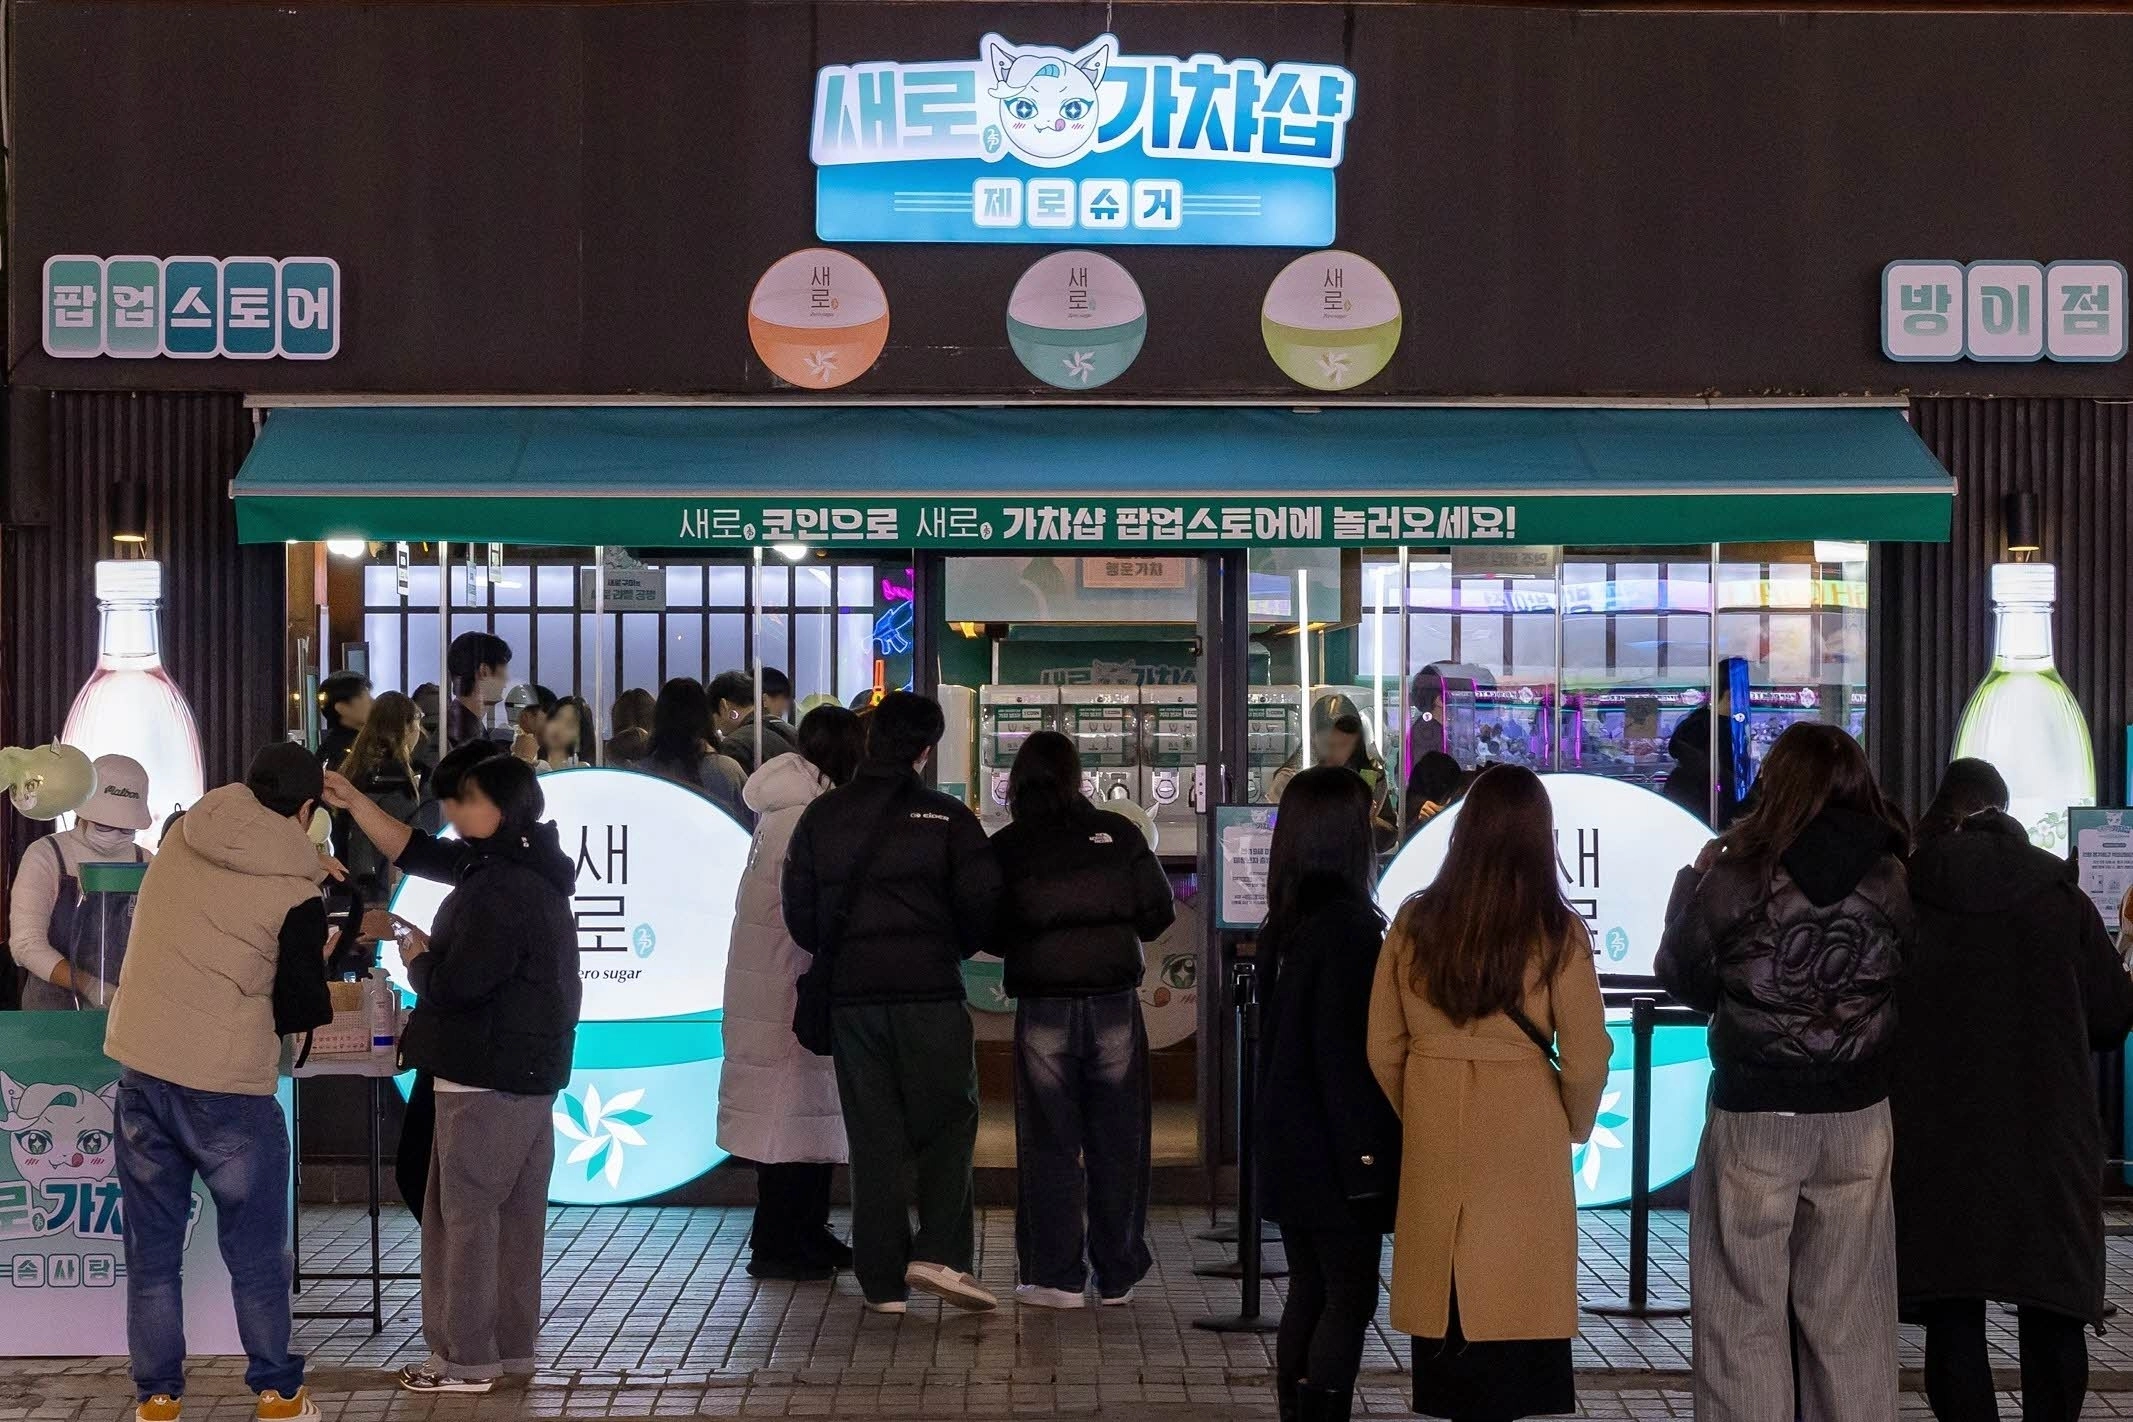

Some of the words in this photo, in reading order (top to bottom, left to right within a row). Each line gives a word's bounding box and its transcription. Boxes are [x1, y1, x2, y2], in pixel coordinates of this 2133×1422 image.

[822, 70, 979, 150] 새로
[1098, 64, 1344, 158] 가챠샵
[54, 285, 328, 330] 팝업스토어
[1900, 284, 2109, 336] 방이점
[680, 508, 742, 539] 새로
[762, 508, 898, 541] 코인으로
[916, 506, 979, 538] 새로
[1003, 506, 1106, 540] 가챠샵
[1116, 507, 1322, 540] 팝업스토어에
[1333, 506, 1516, 540] 놀러오세요!
[577, 969, 600, 979] ero
[602, 969, 642, 983] sugar
